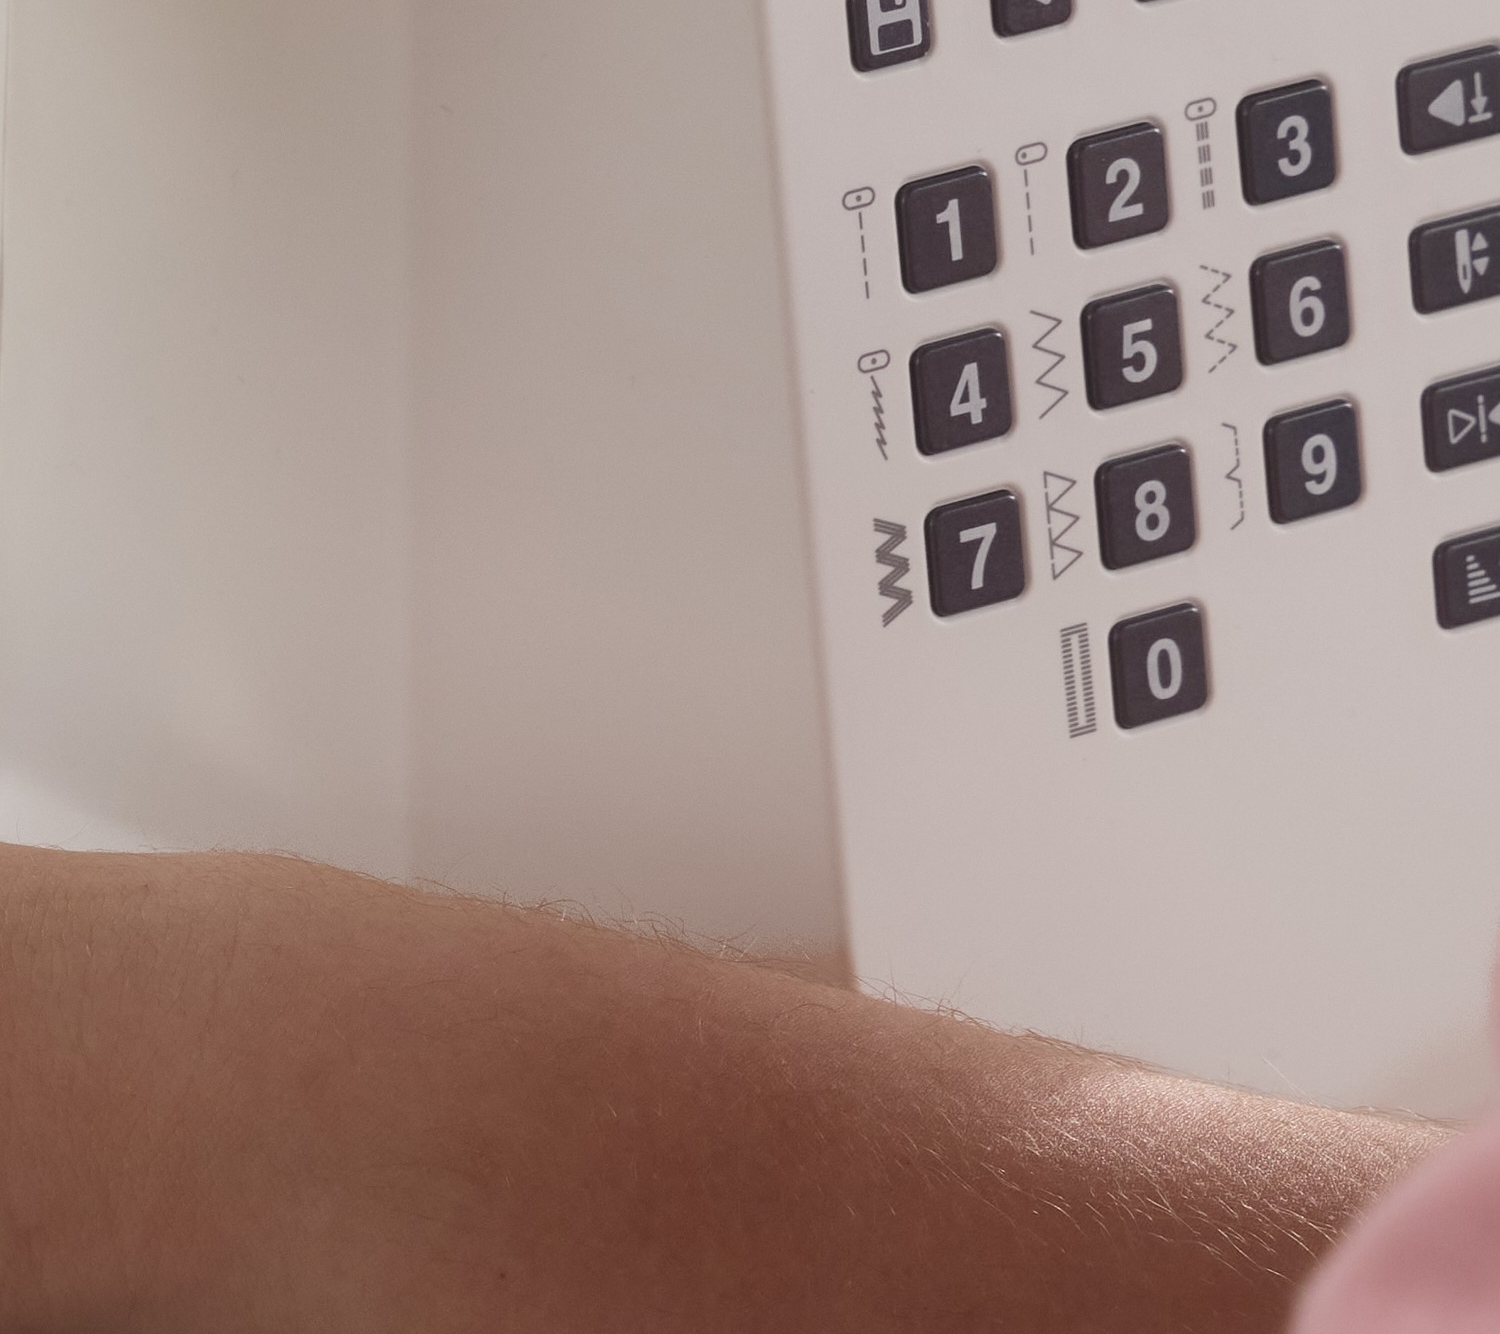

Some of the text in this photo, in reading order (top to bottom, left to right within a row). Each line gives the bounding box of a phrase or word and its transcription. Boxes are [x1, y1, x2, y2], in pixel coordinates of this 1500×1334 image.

[936, 115, 1311, 261] 1 2 3
[950, 276, 1325, 424] 4 5 6
[960, 434, 1337, 589] 7 8 9
[1147, 638, 1182, 699] 0
